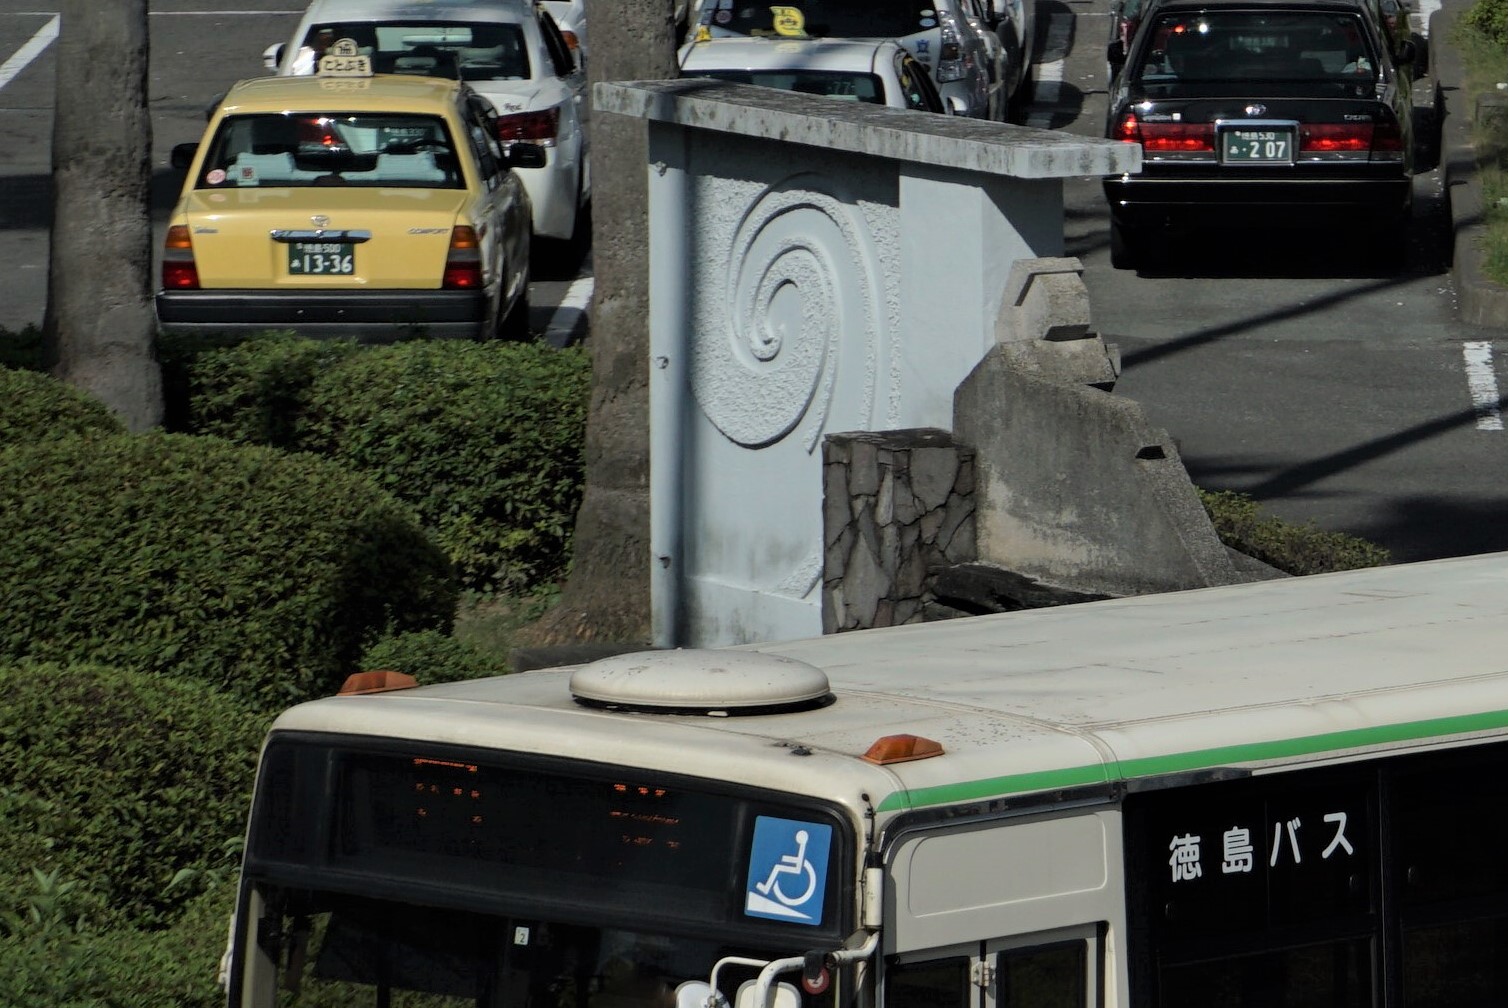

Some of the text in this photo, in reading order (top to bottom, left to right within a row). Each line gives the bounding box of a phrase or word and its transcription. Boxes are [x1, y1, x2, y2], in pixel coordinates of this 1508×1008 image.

[303, 254, 352, 273] 13-36
[1168, 812, 1354, 883] 徳島バス
